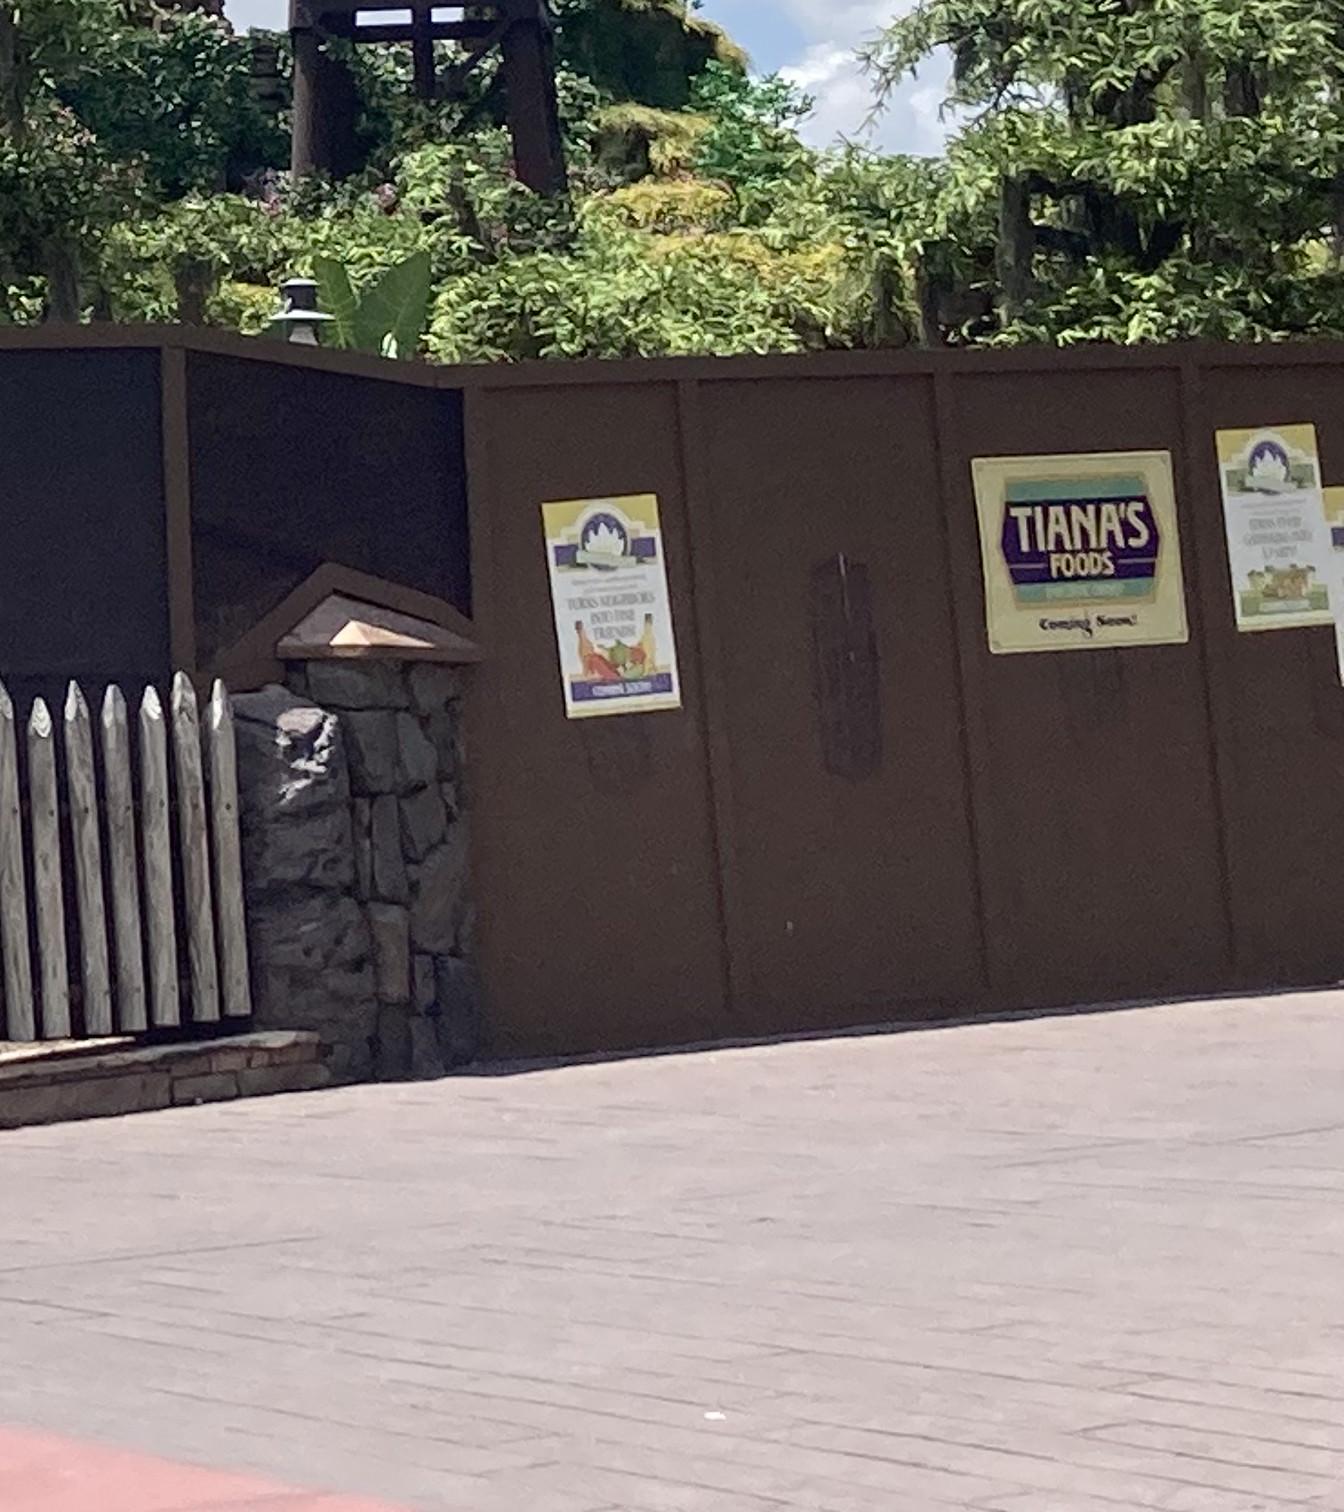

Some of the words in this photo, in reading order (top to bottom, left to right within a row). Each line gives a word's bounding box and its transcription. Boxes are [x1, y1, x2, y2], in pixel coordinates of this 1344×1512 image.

[1009, 501, 1149, 553] TIANA'S
[1049, 552, 1115, 578] FOODS
[1039, 618, 1093, 639] Coming
